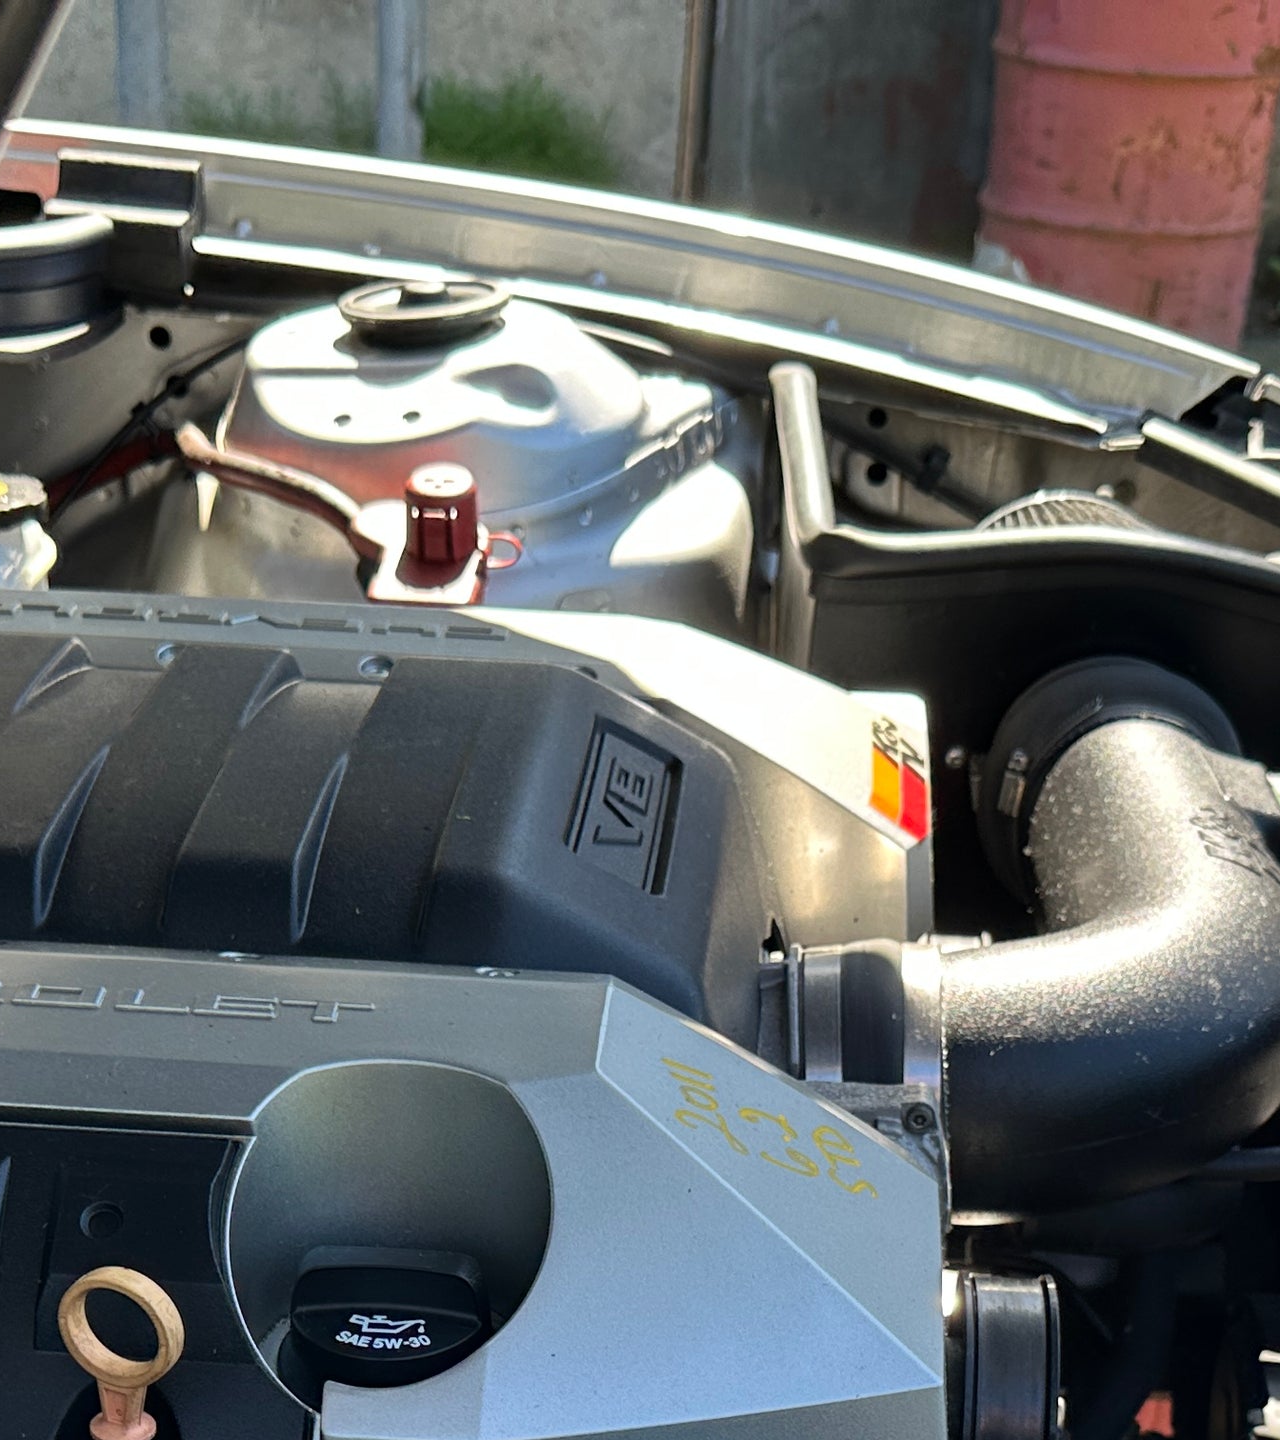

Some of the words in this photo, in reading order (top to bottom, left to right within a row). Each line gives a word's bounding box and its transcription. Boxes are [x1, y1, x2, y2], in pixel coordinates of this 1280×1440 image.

[661, 1056, 750, 1156] 2011
[334, 1330, 372, 1348] SAE
[371, 1334, 432, 1349] 5W-30
